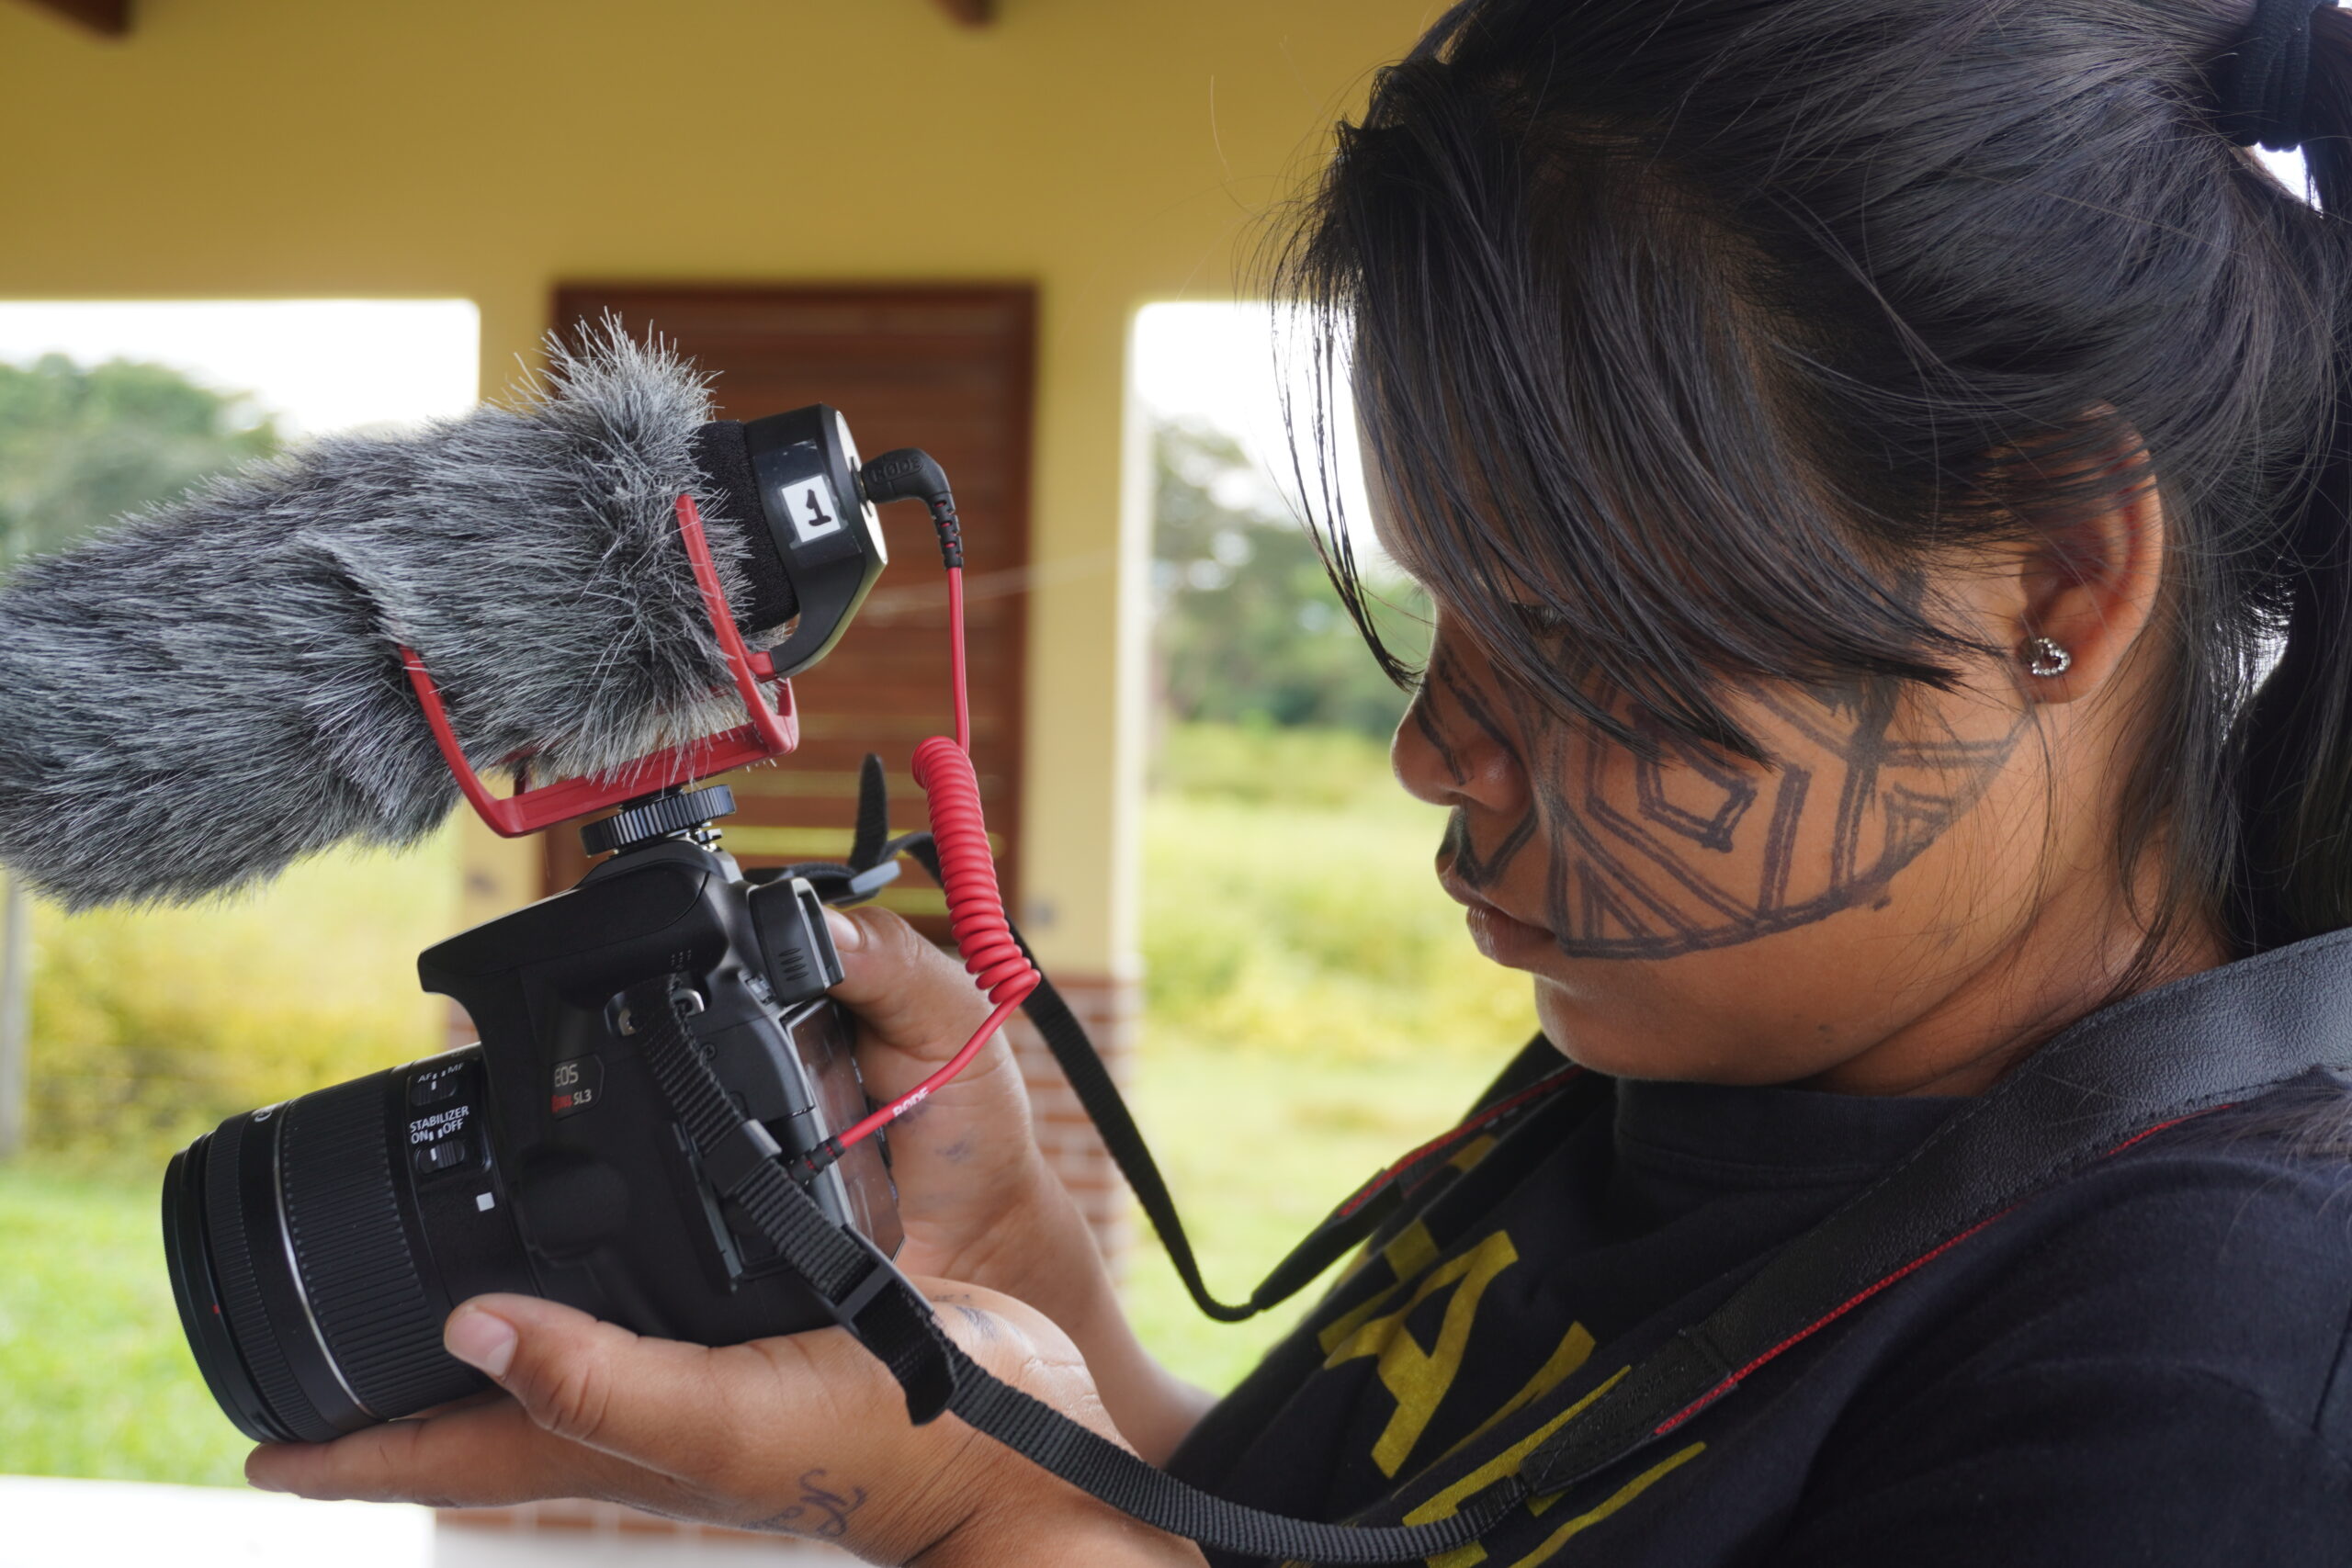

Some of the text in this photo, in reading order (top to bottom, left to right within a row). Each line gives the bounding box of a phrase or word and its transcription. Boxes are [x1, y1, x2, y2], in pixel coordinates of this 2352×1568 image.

[806, 489, 832, 527] 1
[418, 1072, 432, 1084] AF
[554, 1063, 579, 1088] EOS
[573, 1088, 593, 1106] SL3
[410, 1105, 469, 1134] STABILIZER
[411, 1118, 463, 1145] ON OFF
